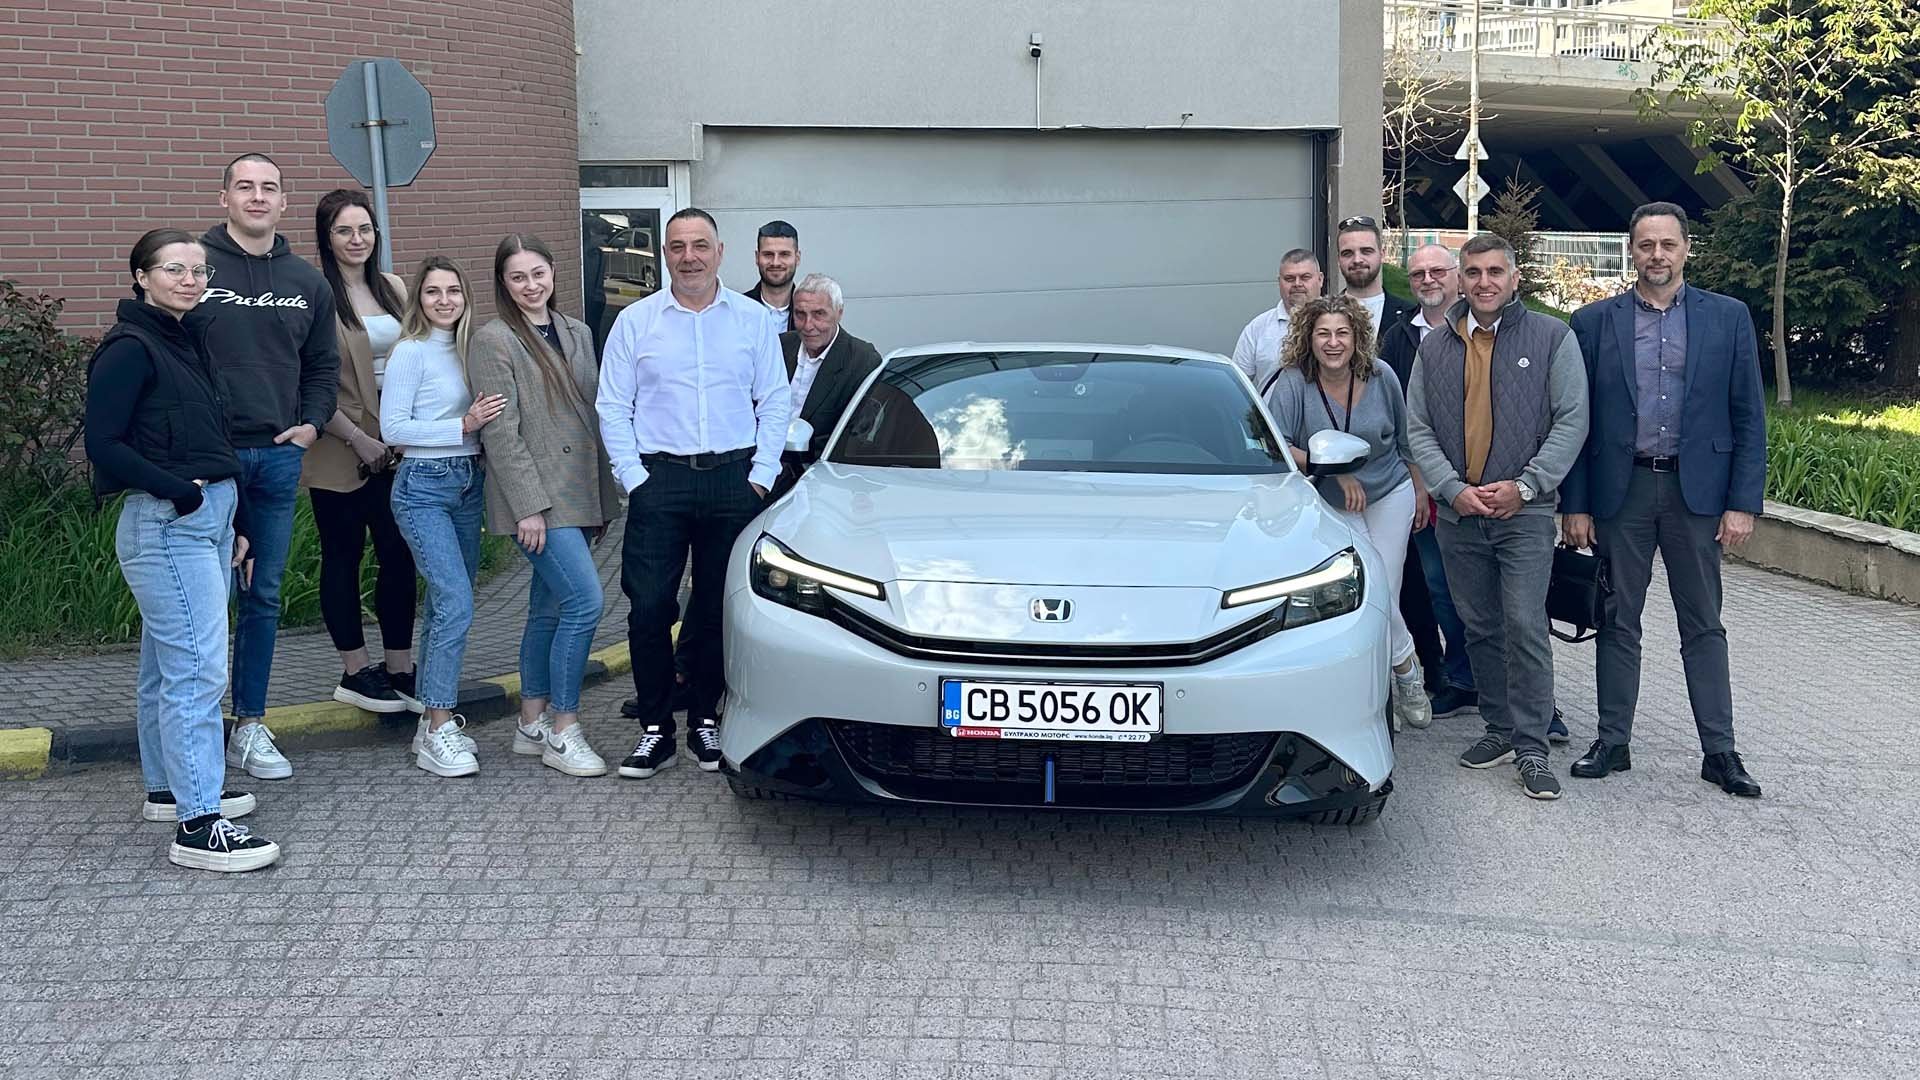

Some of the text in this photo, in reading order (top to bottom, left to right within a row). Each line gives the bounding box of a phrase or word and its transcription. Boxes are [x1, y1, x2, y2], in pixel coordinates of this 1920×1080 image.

[200, 287, 309, 309] Prelude
[945, 709, 960, 720] BG
[967, 688, 1153, 726] CB 5056 OK
[966, 728, 1001, 737] HONDA
